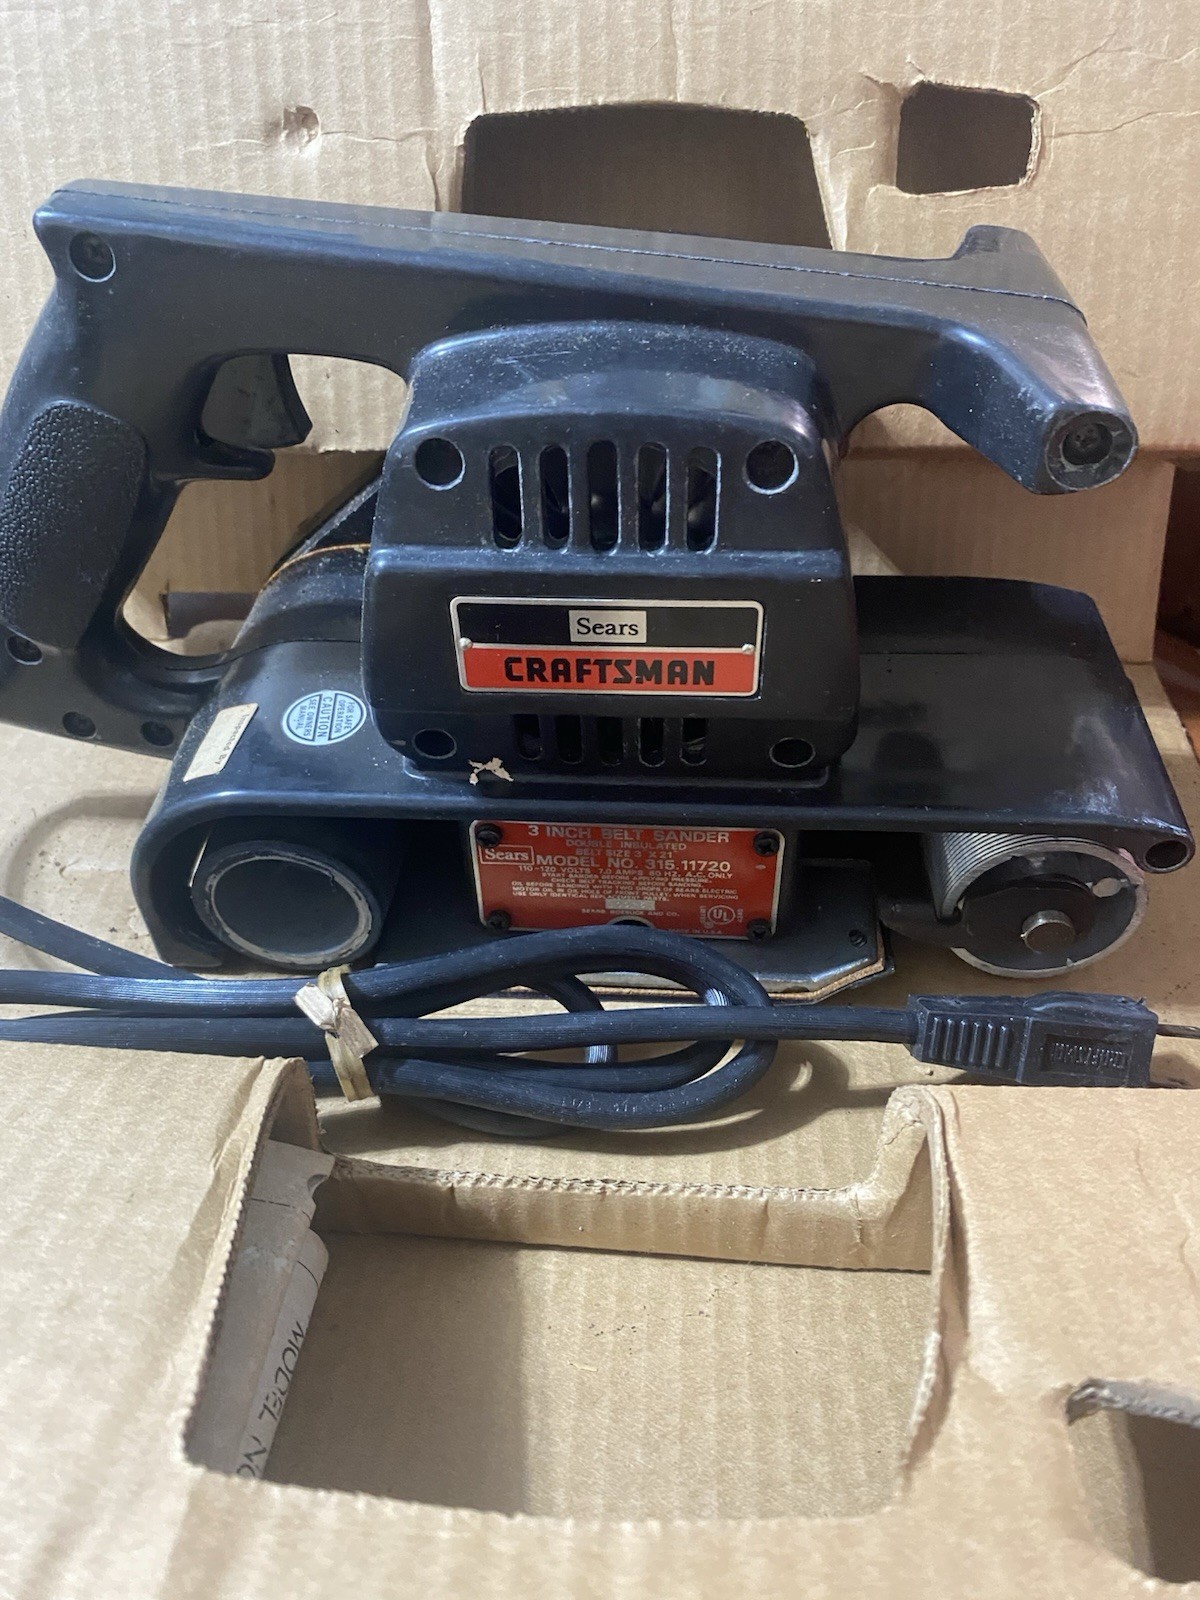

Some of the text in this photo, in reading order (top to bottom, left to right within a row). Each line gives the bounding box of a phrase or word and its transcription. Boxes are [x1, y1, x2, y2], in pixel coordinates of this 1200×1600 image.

[576, 616, 639, 637] Sears
[504, 656, 715, 686] CRAFTSMAN
[296, 705, 308, 730] MANUAL
[303, 699, 318, 737] SEE OWNERS
[317, 696, 333, 738] CAUTION
[334, 699, 346, 734] OPERATION
[343, 701, 355, 730] FOR SAFE
[527, 824, 731, 844] 3 INCH BELT SANDER
[484, 848, 530, 861] Sears
[565, 839, 687, 851] DOUBLE INSULATED
[575, 847, 600, 856] BELT
[605, 849, 630, 858] SIZE
[536, 854, 731, 873] MODEL NO. 315.11720
[598, 867, 612, 875] 7.0
[615, 868, 644, 877] AMPS
[685, 871, 706, 879] A.C.
[707, 872, 733, 880] ONLY
[712, 908, 729, 922] UL
[258, 1320, 305, 1421] MODEL
